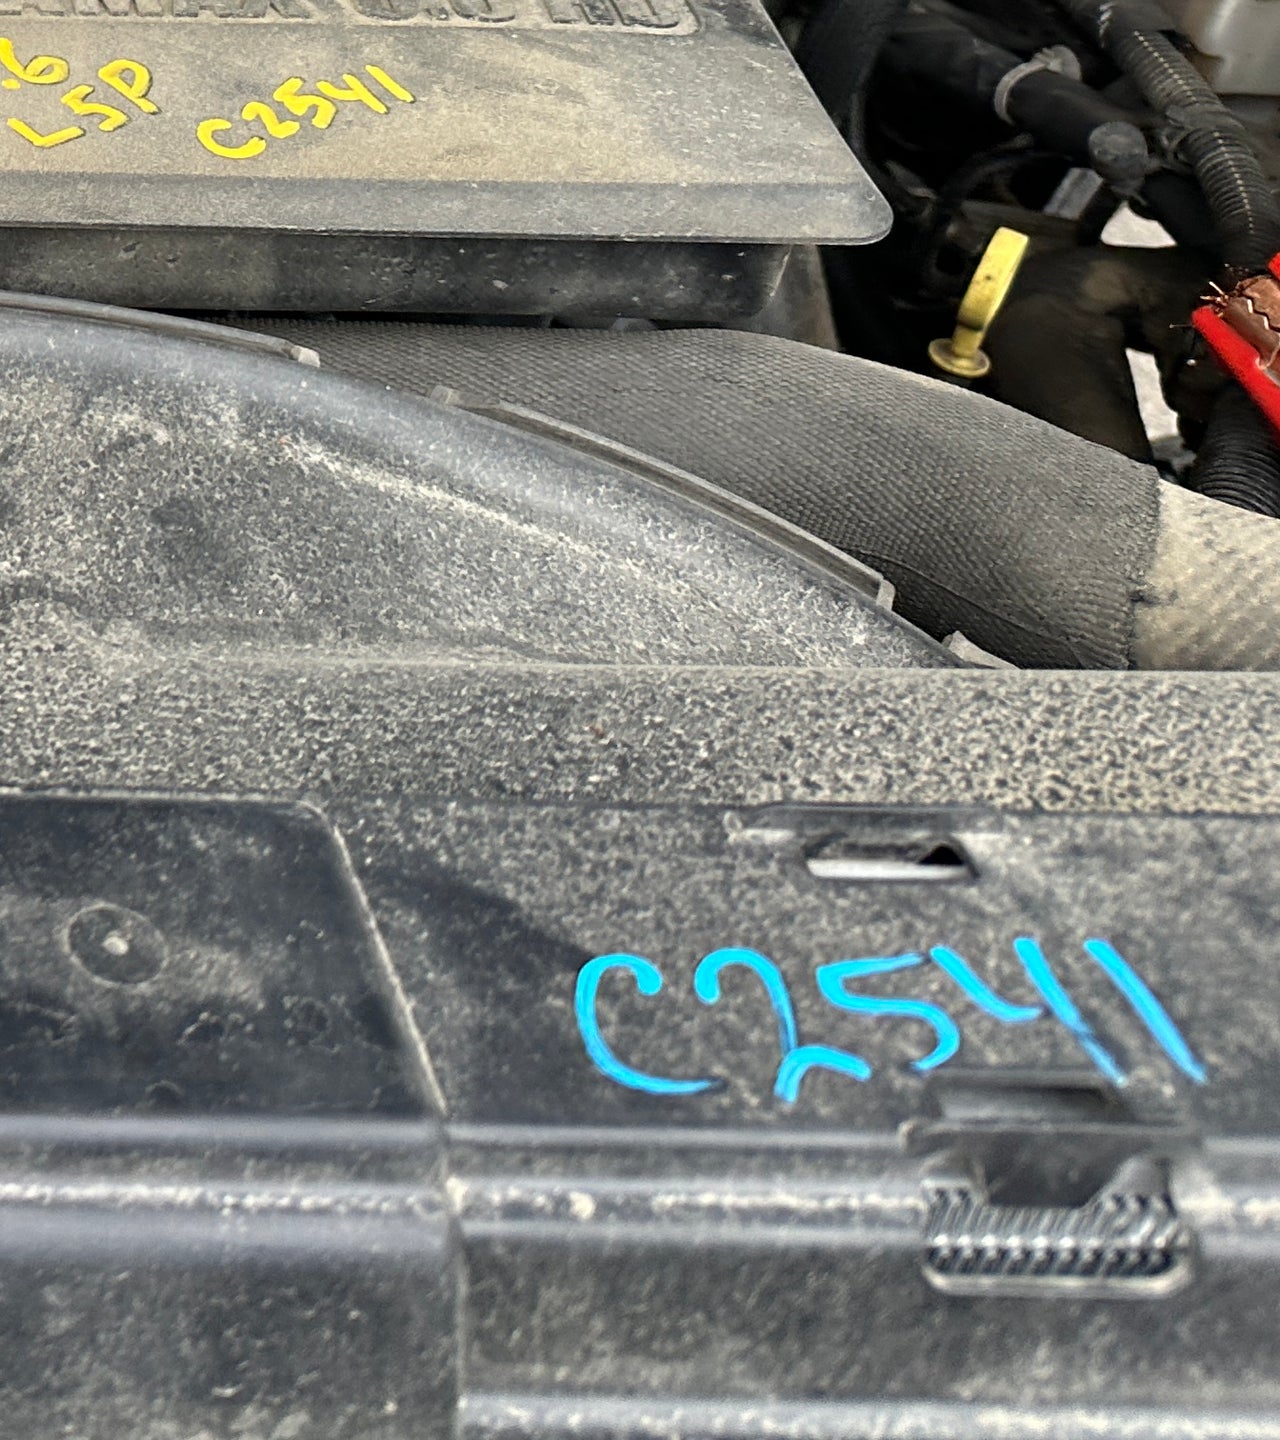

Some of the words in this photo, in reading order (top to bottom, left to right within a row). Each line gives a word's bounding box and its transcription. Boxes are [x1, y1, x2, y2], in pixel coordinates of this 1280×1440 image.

[8, 57, 158, 148] L5P
[195, 66, 413, 160] C2541
[572, 935, 1209, 1102] C2541
